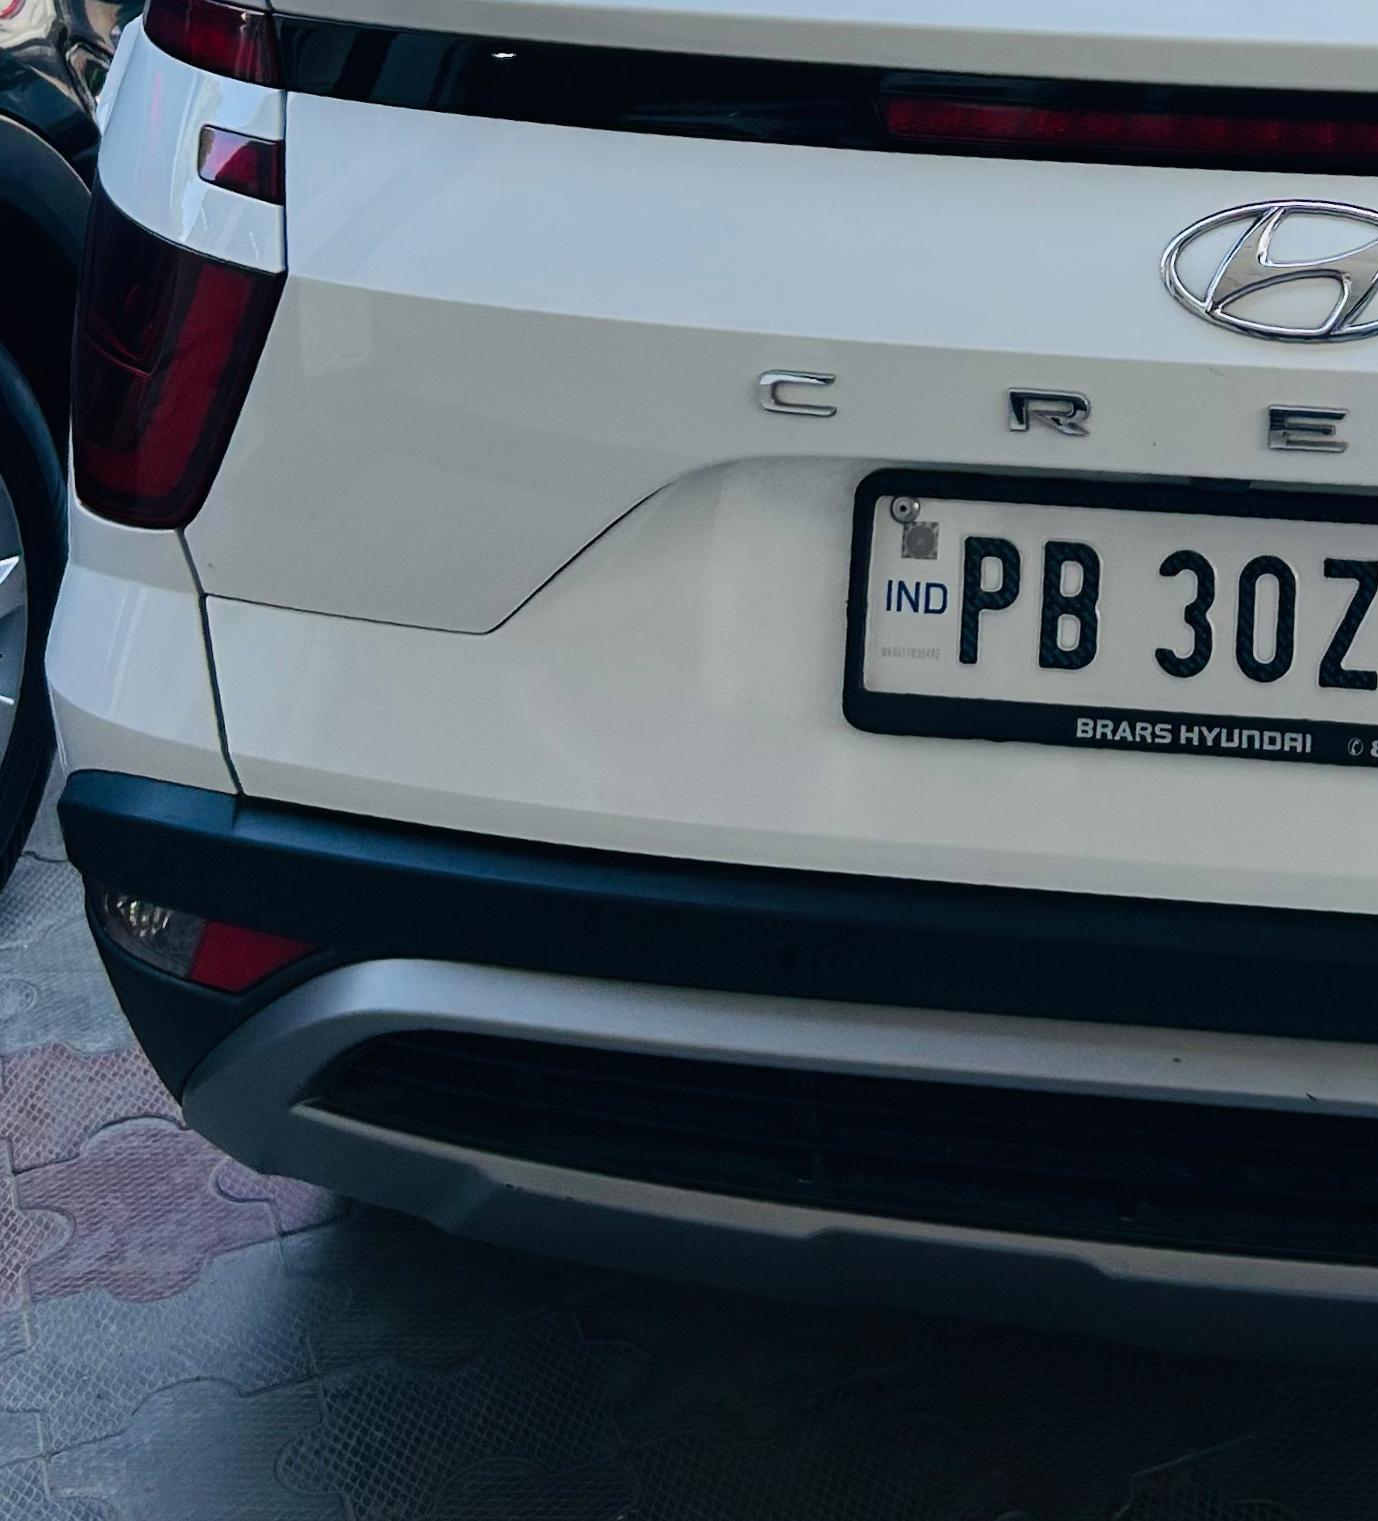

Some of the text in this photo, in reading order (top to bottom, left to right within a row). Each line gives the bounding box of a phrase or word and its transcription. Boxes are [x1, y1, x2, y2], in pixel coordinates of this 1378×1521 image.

[886, 579, 949, 615] IND
[959, 535, 1102, 671] PB
[1076, 717, 1173, 745] BRARS
[1179, 724, 1313, 754] HYUNDAI
